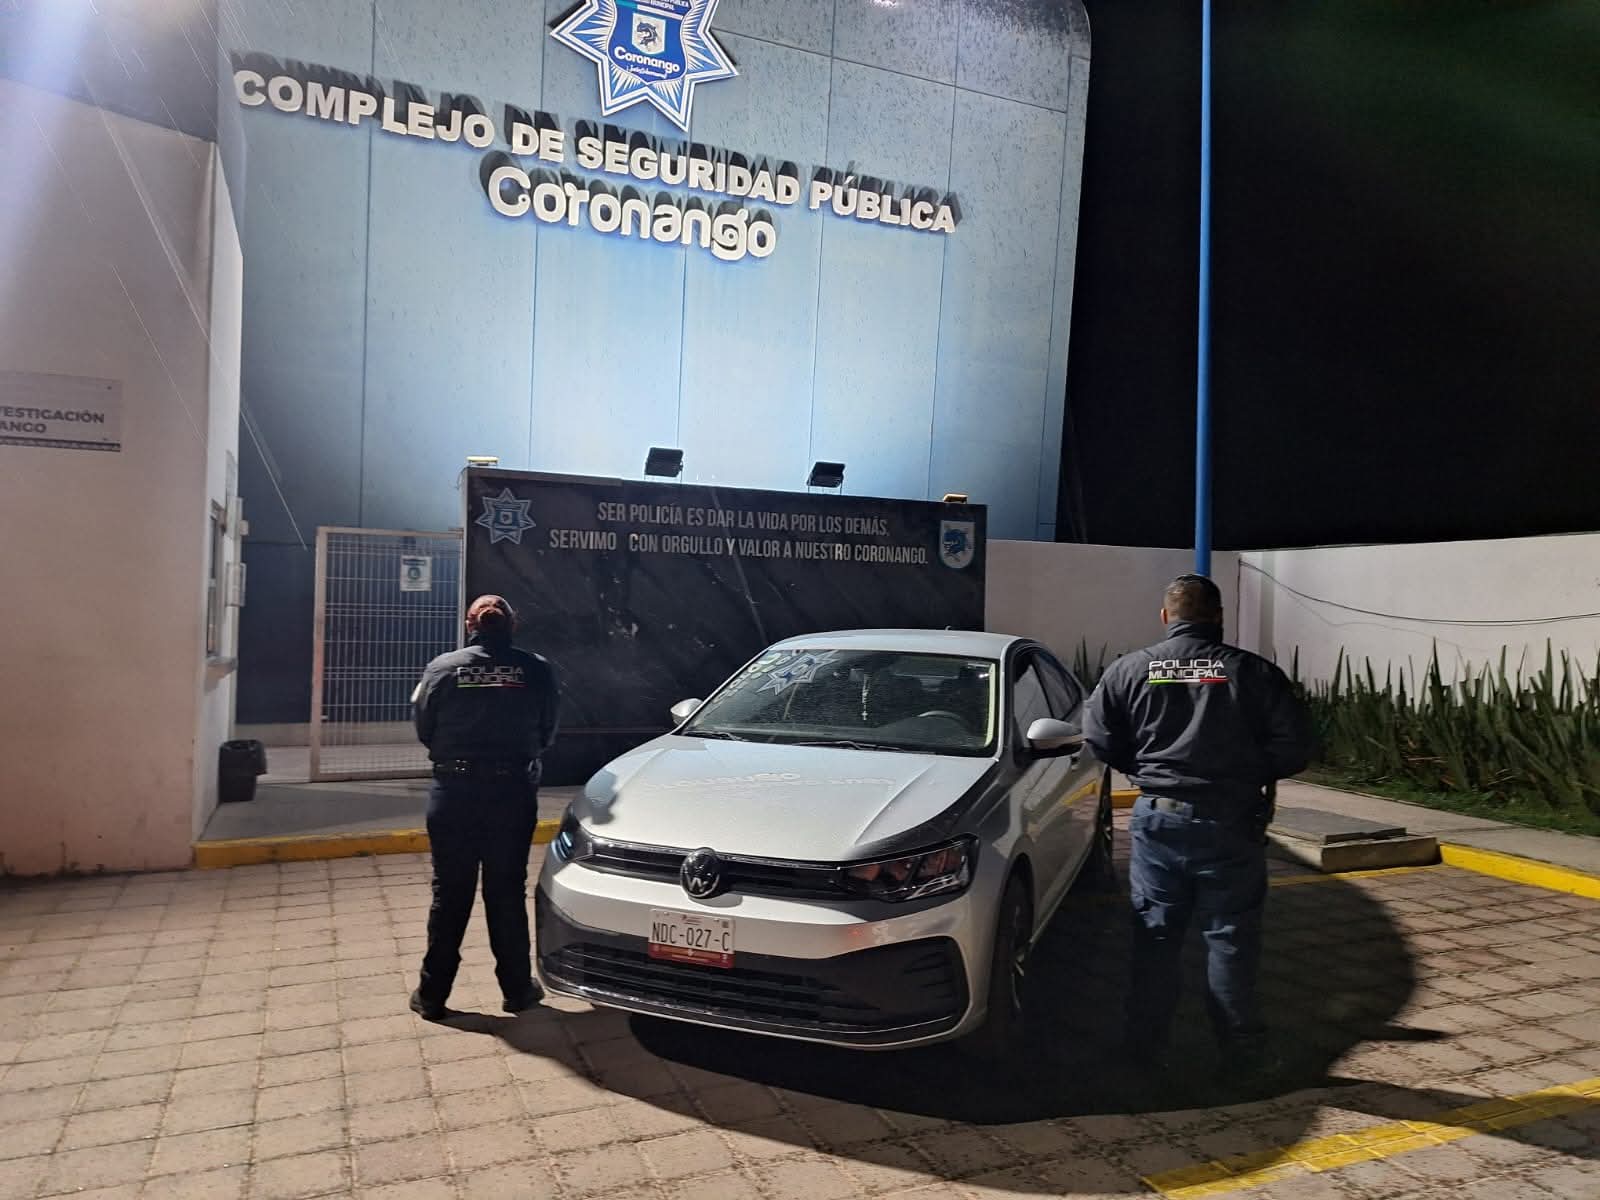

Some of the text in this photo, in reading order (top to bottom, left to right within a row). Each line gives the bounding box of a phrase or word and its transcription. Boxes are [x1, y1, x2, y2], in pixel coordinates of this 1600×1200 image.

[614, 46, 680, 74] Coronango
[233, 70, 956, 233] COMPLEJO DE SEGURIDAD PÚBLICA
[488, 166, 777, 261] Coronango
[597, 502, 890, 537] SER POLICÍA ES DAR LA VIDA POR LOS DEMÁS.
[550, 529, 929, 565] SERVIMO CON ORGULLO Y VALOR A NUESTRO CORONANGO.
[1148, 669, 1227, 680] MUNICIPAL
[651, 921, 730, 952] NDC-027-C
